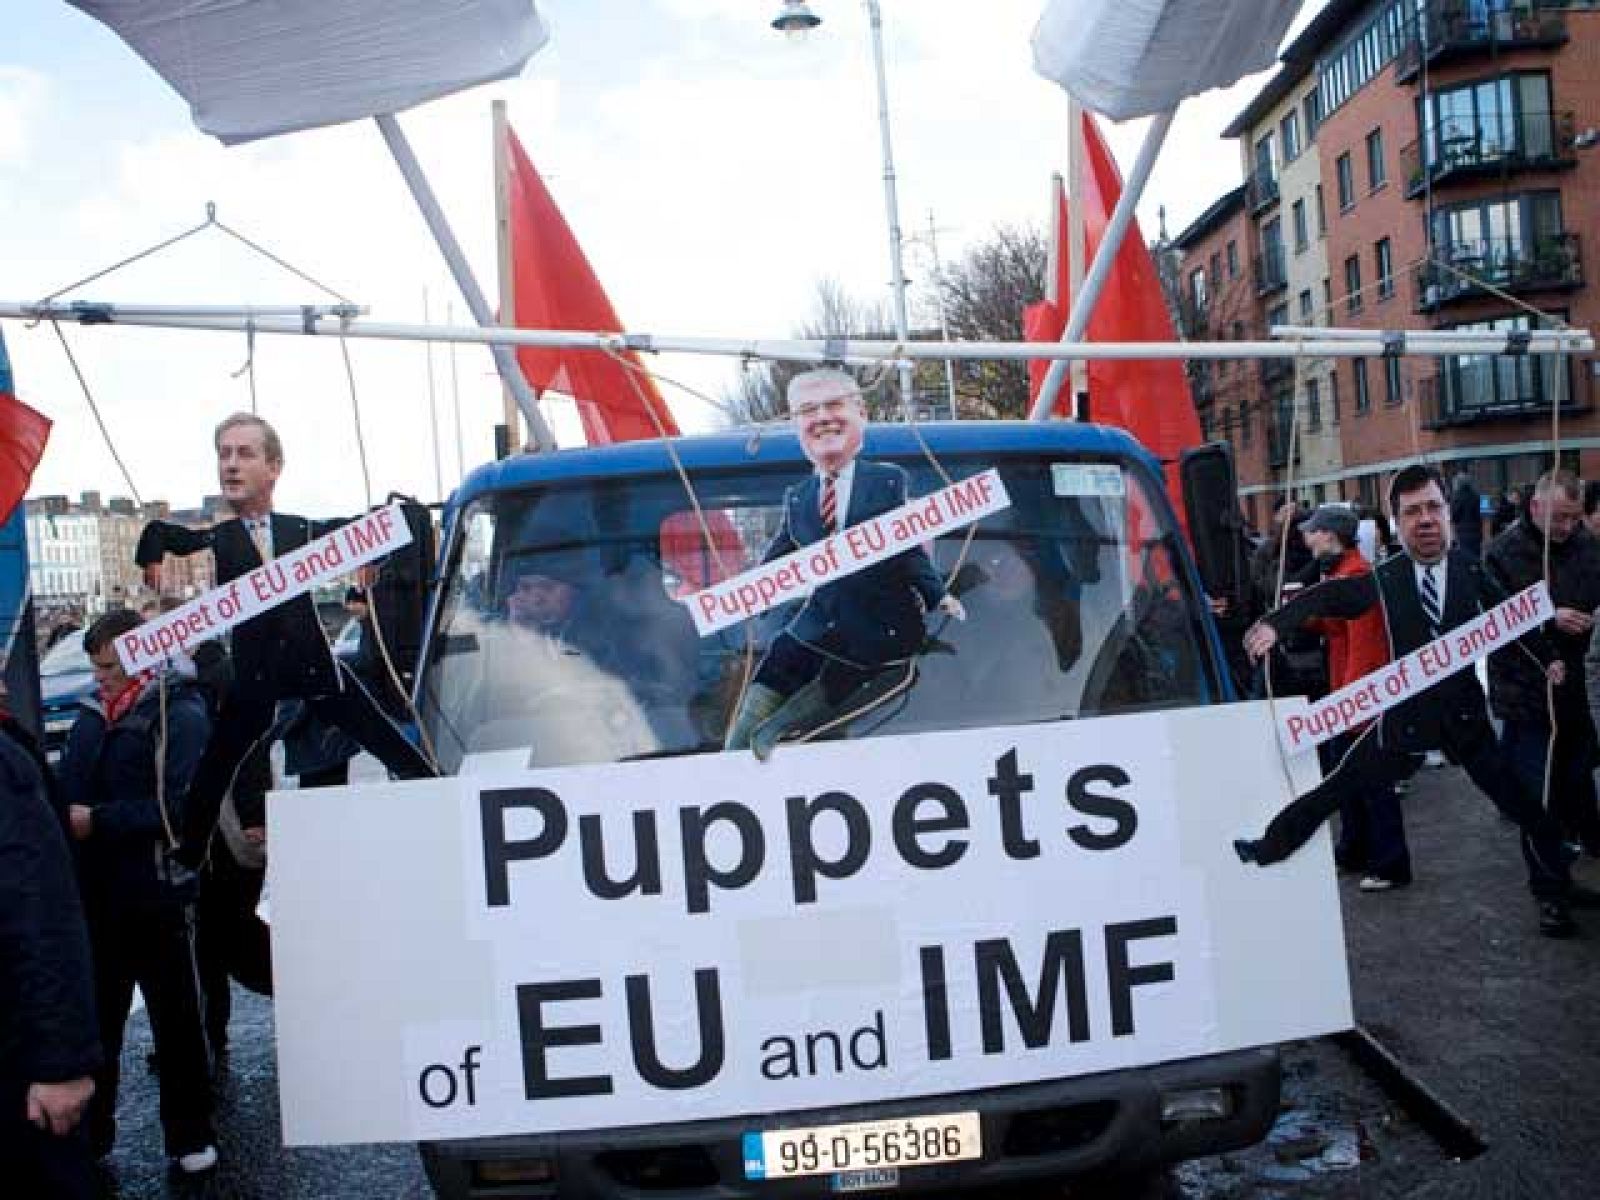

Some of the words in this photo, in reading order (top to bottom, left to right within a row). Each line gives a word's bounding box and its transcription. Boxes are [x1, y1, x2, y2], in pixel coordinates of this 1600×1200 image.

[124, 607, 216, 662] Puppet
[216, 584, 242, 619] of
[249, 564, 288, 603] EU
[293, 534, 343, 583] and
[344, 508, 394, 556] IMF
[699, 561, 806, 623] Puppet
[809, 540, 840, 575] of
[845, 523, 885, 561] EU
[894, 499, 945, 541] and
[946, 475, 996, 517] IMF
[1286, 682, 1381, 744] Puppet
[1384, 660, 1411, 696] of
[1418, 640, 1451, 677] EU
[1458, 614, 1500, 659] and
[1501, 588, 1540, 630] IMF
[477, 747, 1138, 913] Puppets
[417, 1046, 481, 1108] of
[516, 966, 726, 1101] EU
[759, 1011, 888, 1080] and
[919, 914, 1179, 1061] IMF
[780, 1125, 961, 1172] 99-D-56386
